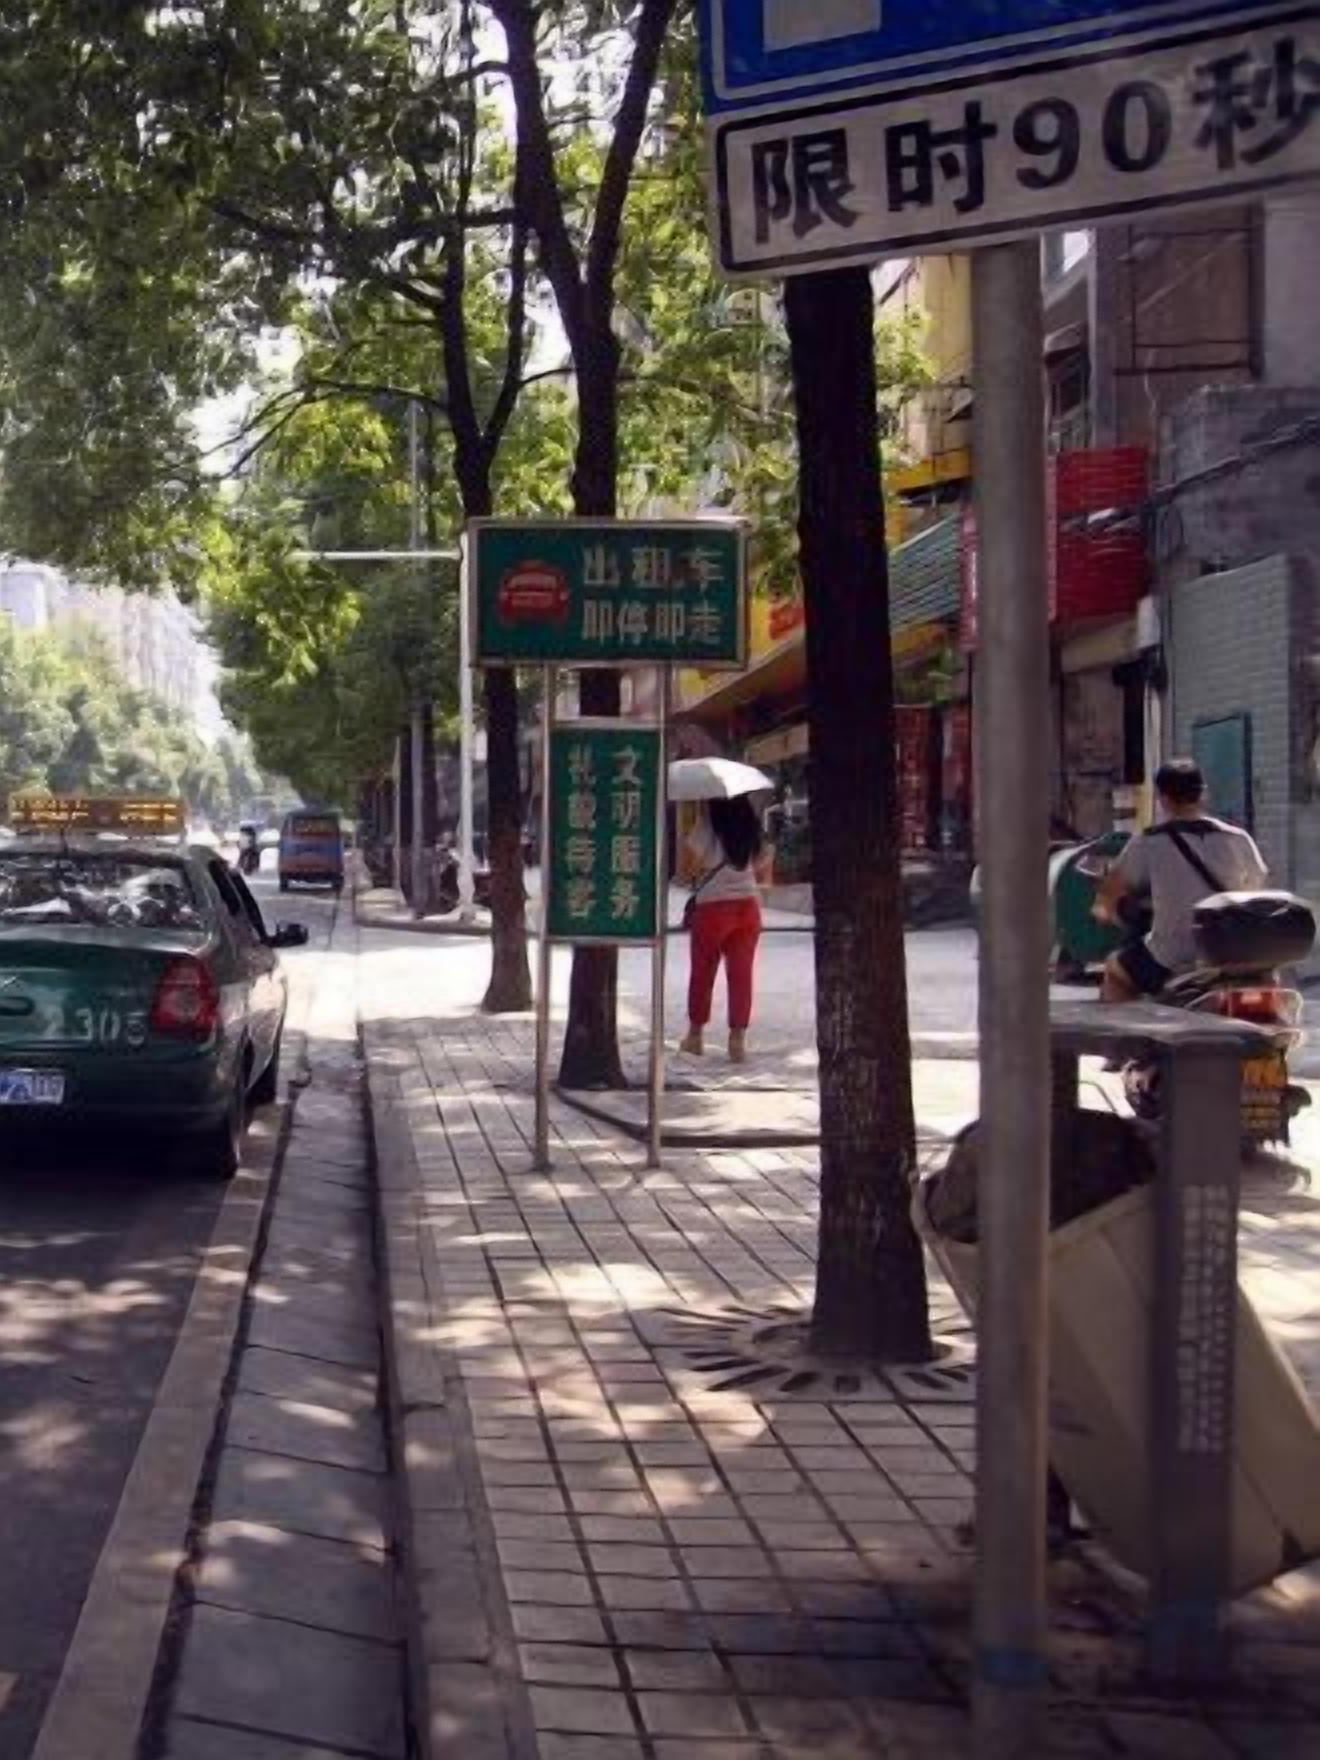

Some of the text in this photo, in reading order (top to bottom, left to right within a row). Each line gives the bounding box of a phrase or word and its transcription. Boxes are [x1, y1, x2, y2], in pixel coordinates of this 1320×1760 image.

[750, 36, 1320, 244] 限时90秒
[582, 545, 723, 594] 出租车
